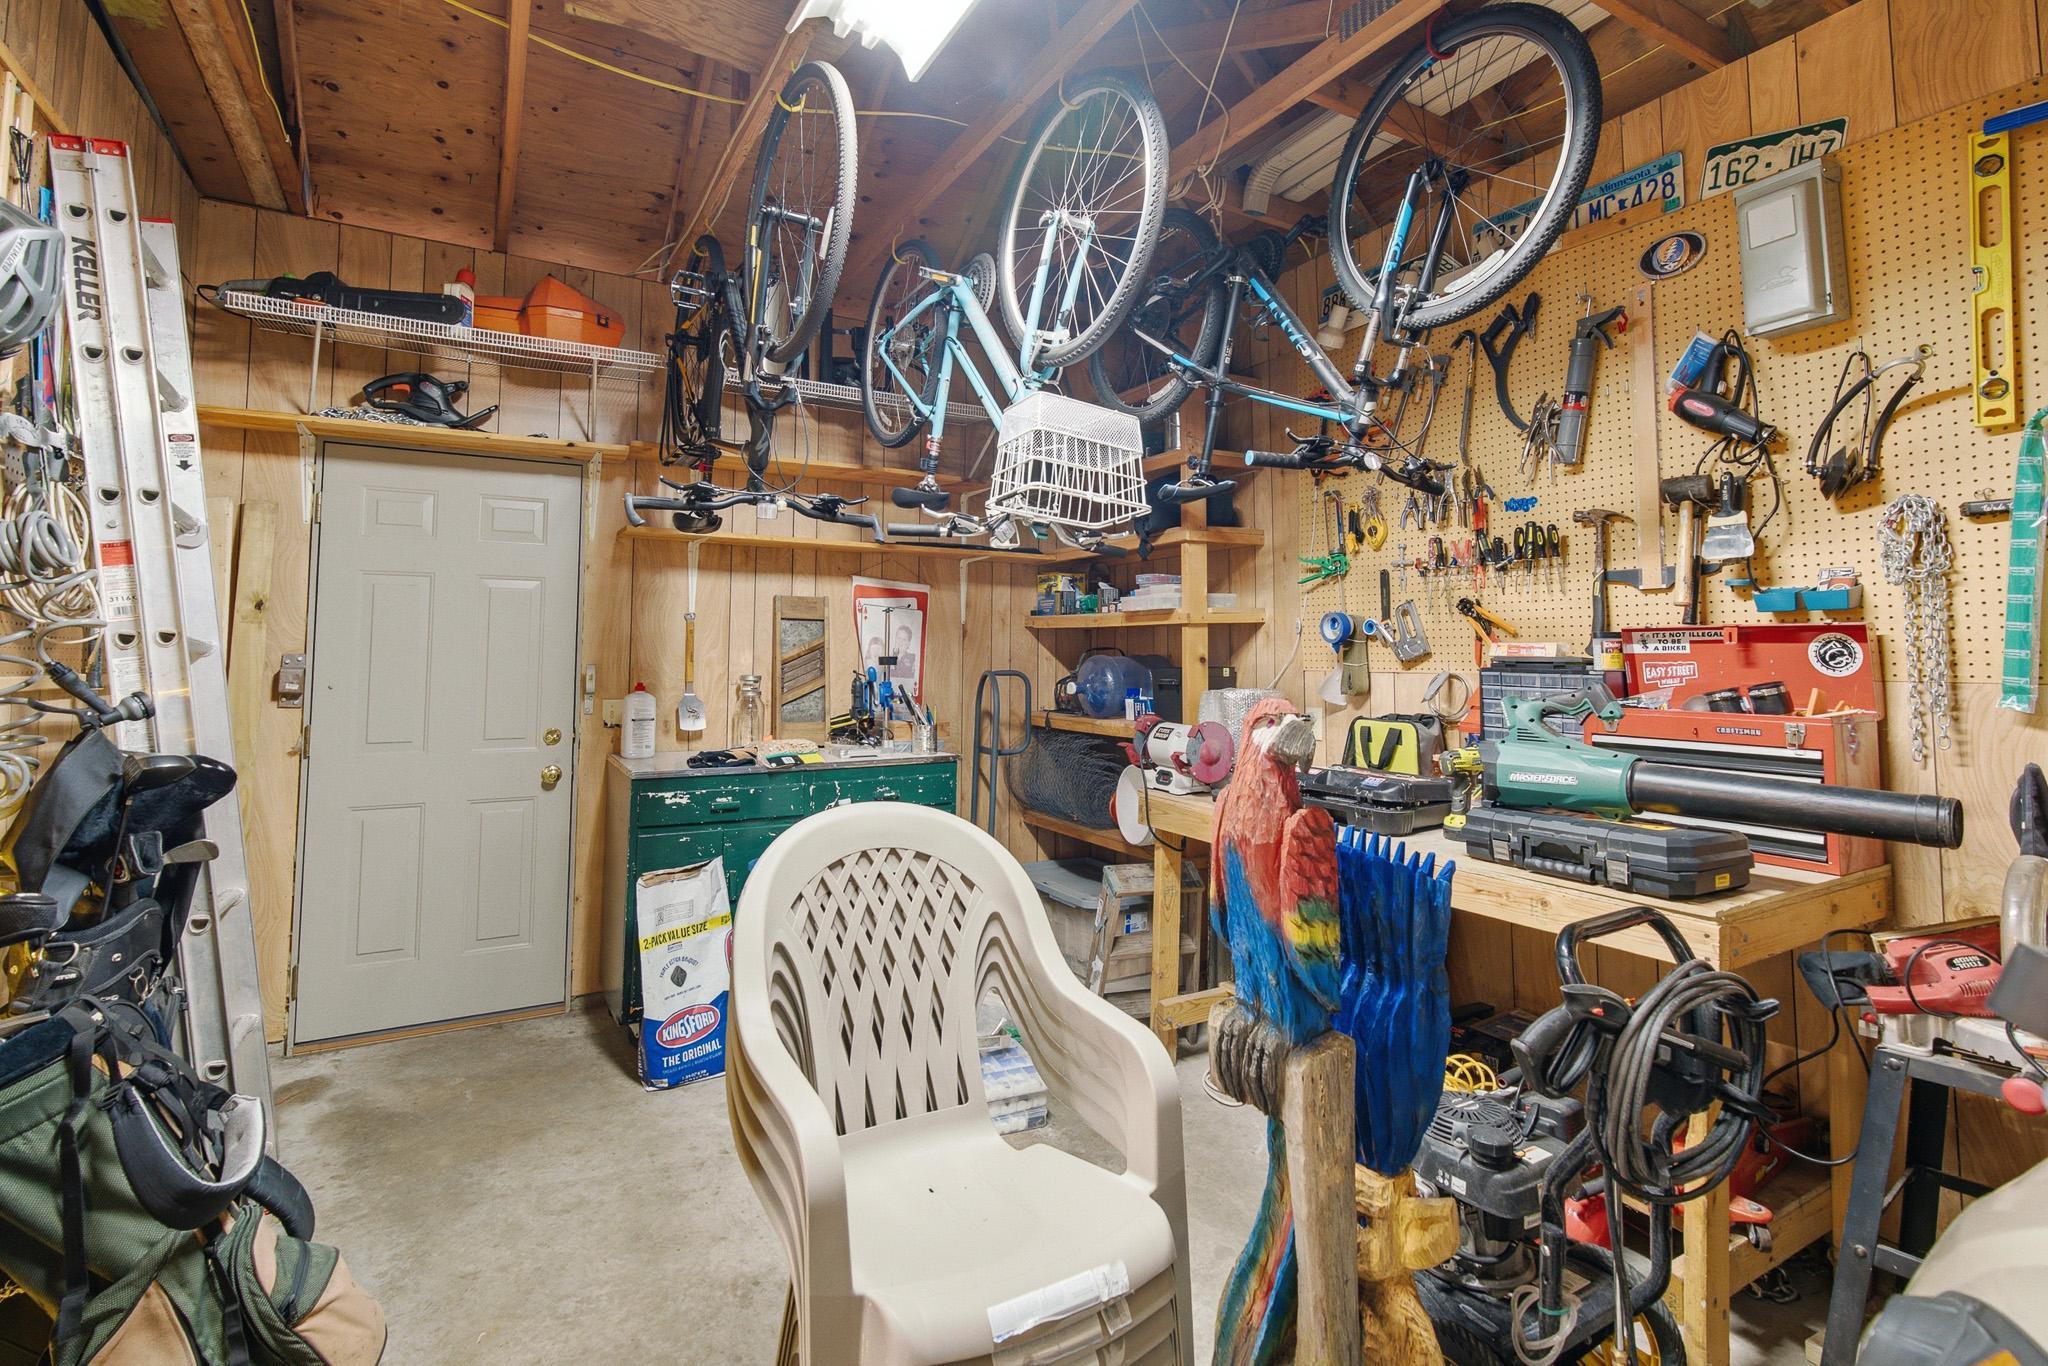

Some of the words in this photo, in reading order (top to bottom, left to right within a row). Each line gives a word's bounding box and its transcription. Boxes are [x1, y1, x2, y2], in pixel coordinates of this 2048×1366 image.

[1600, 168, 1652, 194] Minnesota
[1708, 153, 1760, 191] 162
[71, 235, 102, 321] KELLER
[1688, 630, 1724, 638] ILLEGAL
[1646, 666, 1665, 678] EASY
[1666, 664, 1695, 677] STREET
[1716, 727, 1761, 736] CRAFTSMAN
[643, 934, 668, 950] 2-PACK
[667, 926, 690, 942] VALUE
[692, 921, 708, 935] SIZE
[1952, 961, 1984, 971] TOOL
[1953, 955, 1980, 964] SHOP
[662, 1011, 715, 1041] KINGSFORD
[662, 1053, 681, 1067] THE
[682, 1038, 722, 1062] ORIGINAL
